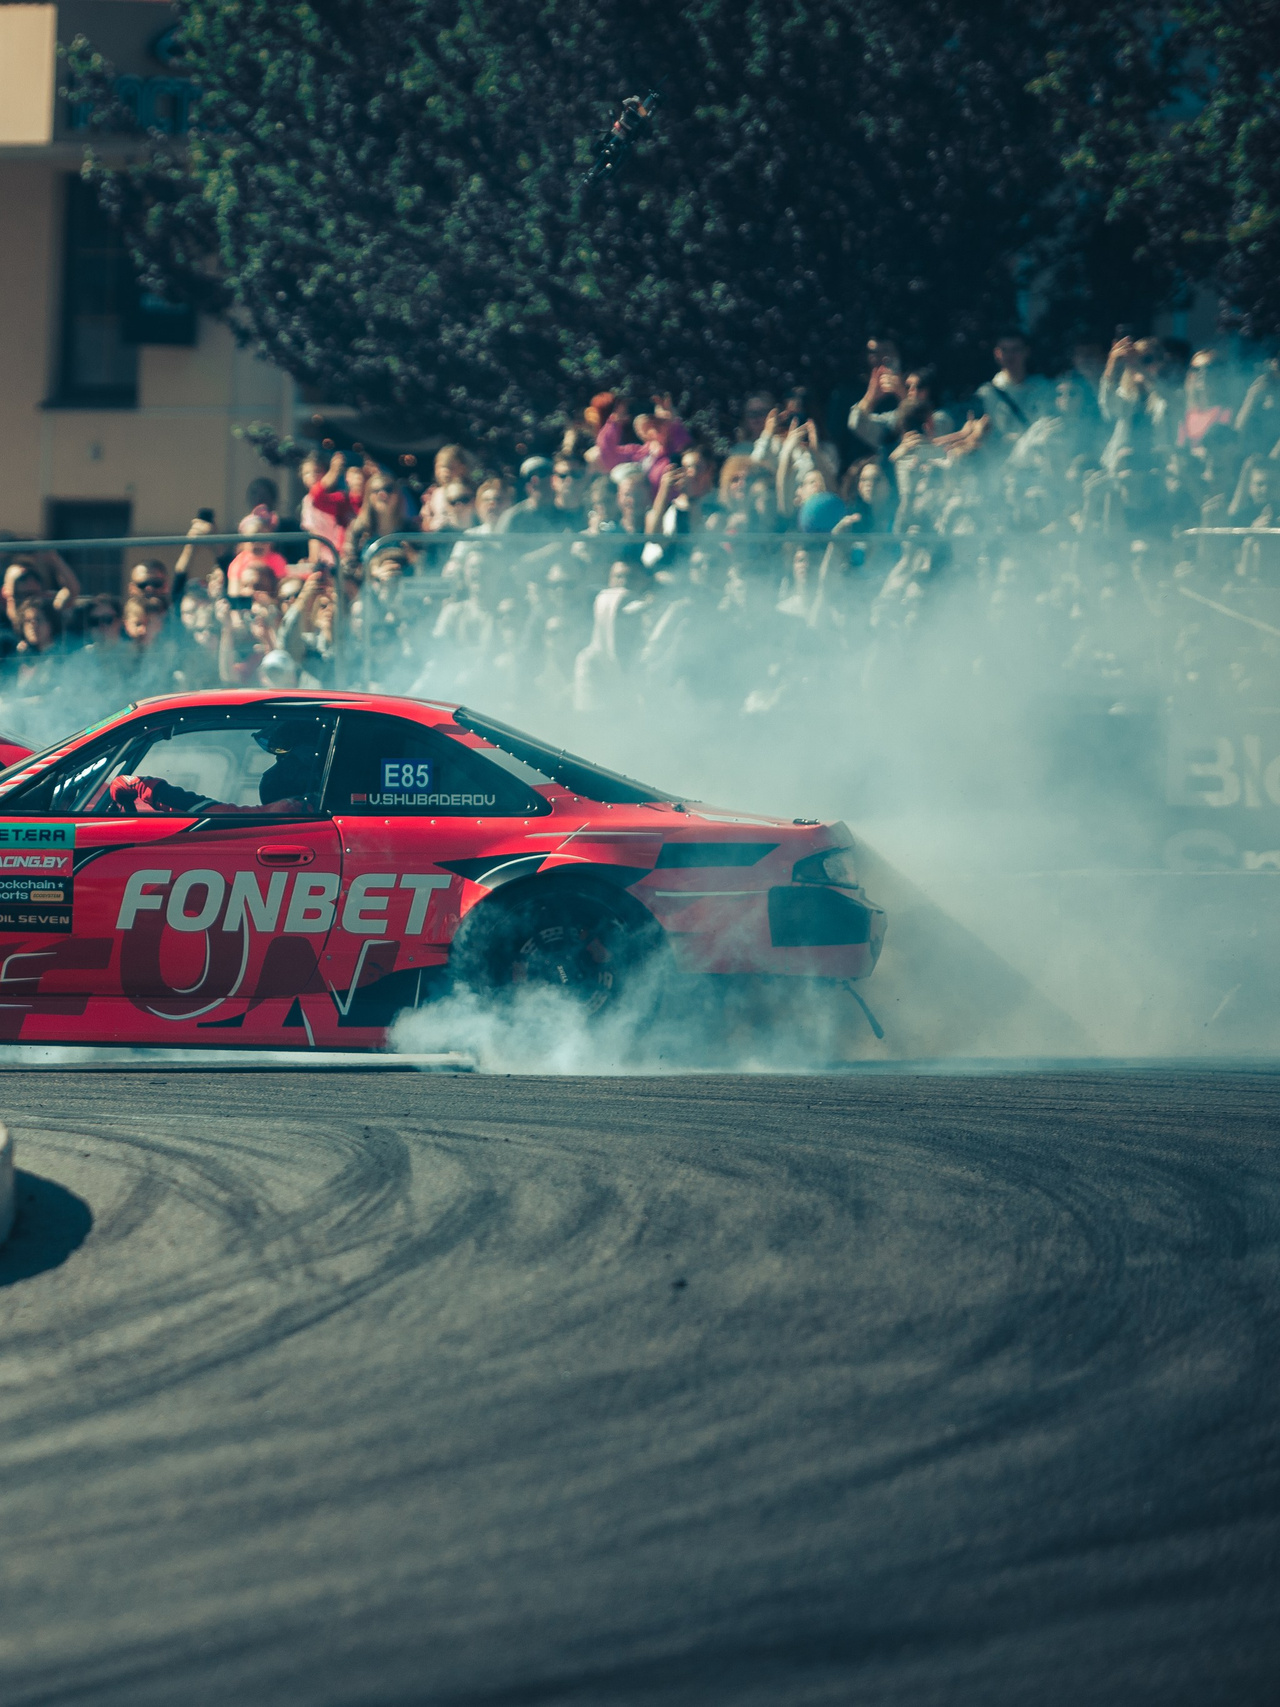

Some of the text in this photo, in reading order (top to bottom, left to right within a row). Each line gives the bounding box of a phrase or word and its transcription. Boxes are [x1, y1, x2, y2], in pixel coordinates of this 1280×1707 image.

[384, 763, 429, 788] E85
[369, 793, 496, 807] V.SHUBADEROV
[115, 868, 453, 935] FONBET
[18, 914, 70, 925] SEVEN
